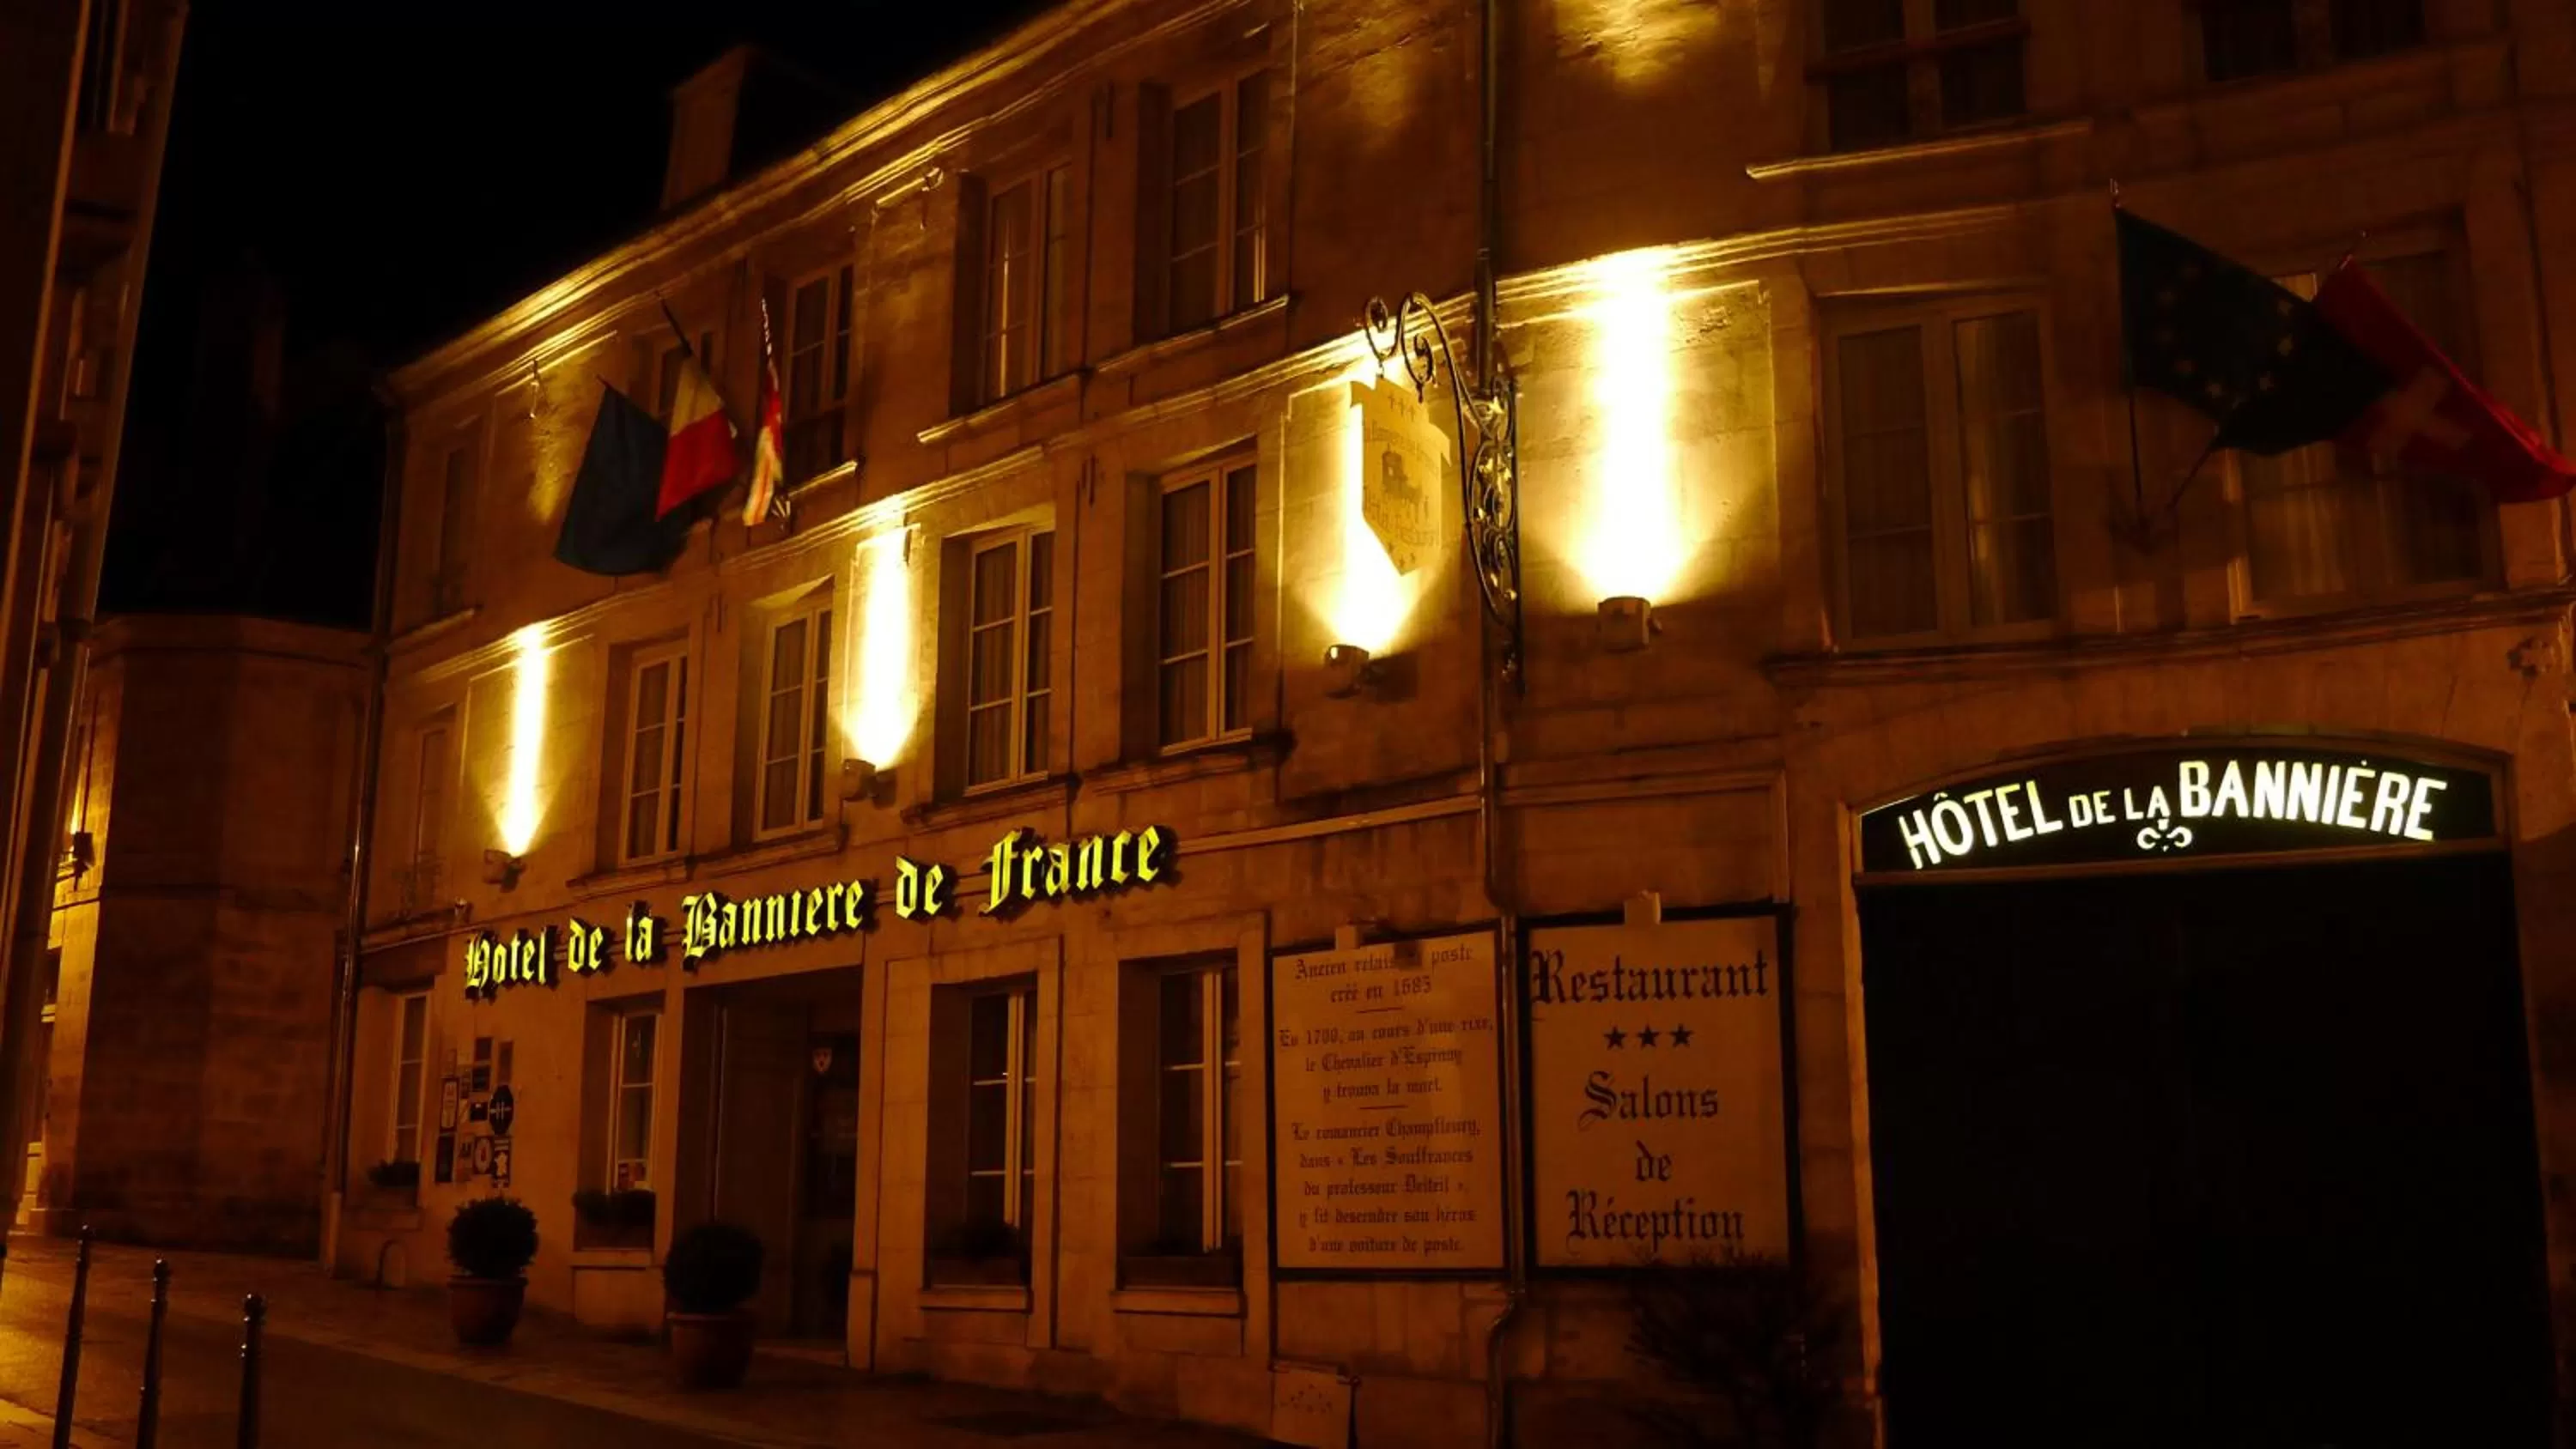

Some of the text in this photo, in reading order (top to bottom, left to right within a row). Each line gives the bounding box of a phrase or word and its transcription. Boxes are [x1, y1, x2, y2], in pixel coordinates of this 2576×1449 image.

[1898, 779, 2063, 870] HÔTEL
[2069, 790, 2116, 828] DE
[2123, 785, 2172, 822] LA
[466, 926, 547, 987] Hotel
[568, 917, 605, 973] de
[624, 905, 653, 962] la
[896, 855, 944, 919] de
[980, 825, 1160, 913] France
[1295, 958, 1347, 980] Ancien
[1431, 943, 1473, 975] poste
[1366, 984, 1383, 1000] en
[1530, 949, 1769, 1020] Restaurant
[1372, 1025, 1410, 1040] cours
[1305, 1057, 1315, 1072] le
[1321, 1052, 1384, 1073] Chevalier
[1387, 1077, 1399, 1094] la
[1578, 1070, 1719, 1130] Salons
[1385, 1143, 1474, 1165] Souffrances
[1635, 1140, 1672, 1182] de
[1304, 1180, 1320, 1196] du
[1327, 1178, 1397, 1199] professeur
[1336, 1205, 1398, 1223] descendre
[1404, 1209, 1430, 1223] son
[1565, 1188, 1746, 1257] Réception
[1402, 1235, 1416, 1252] de
